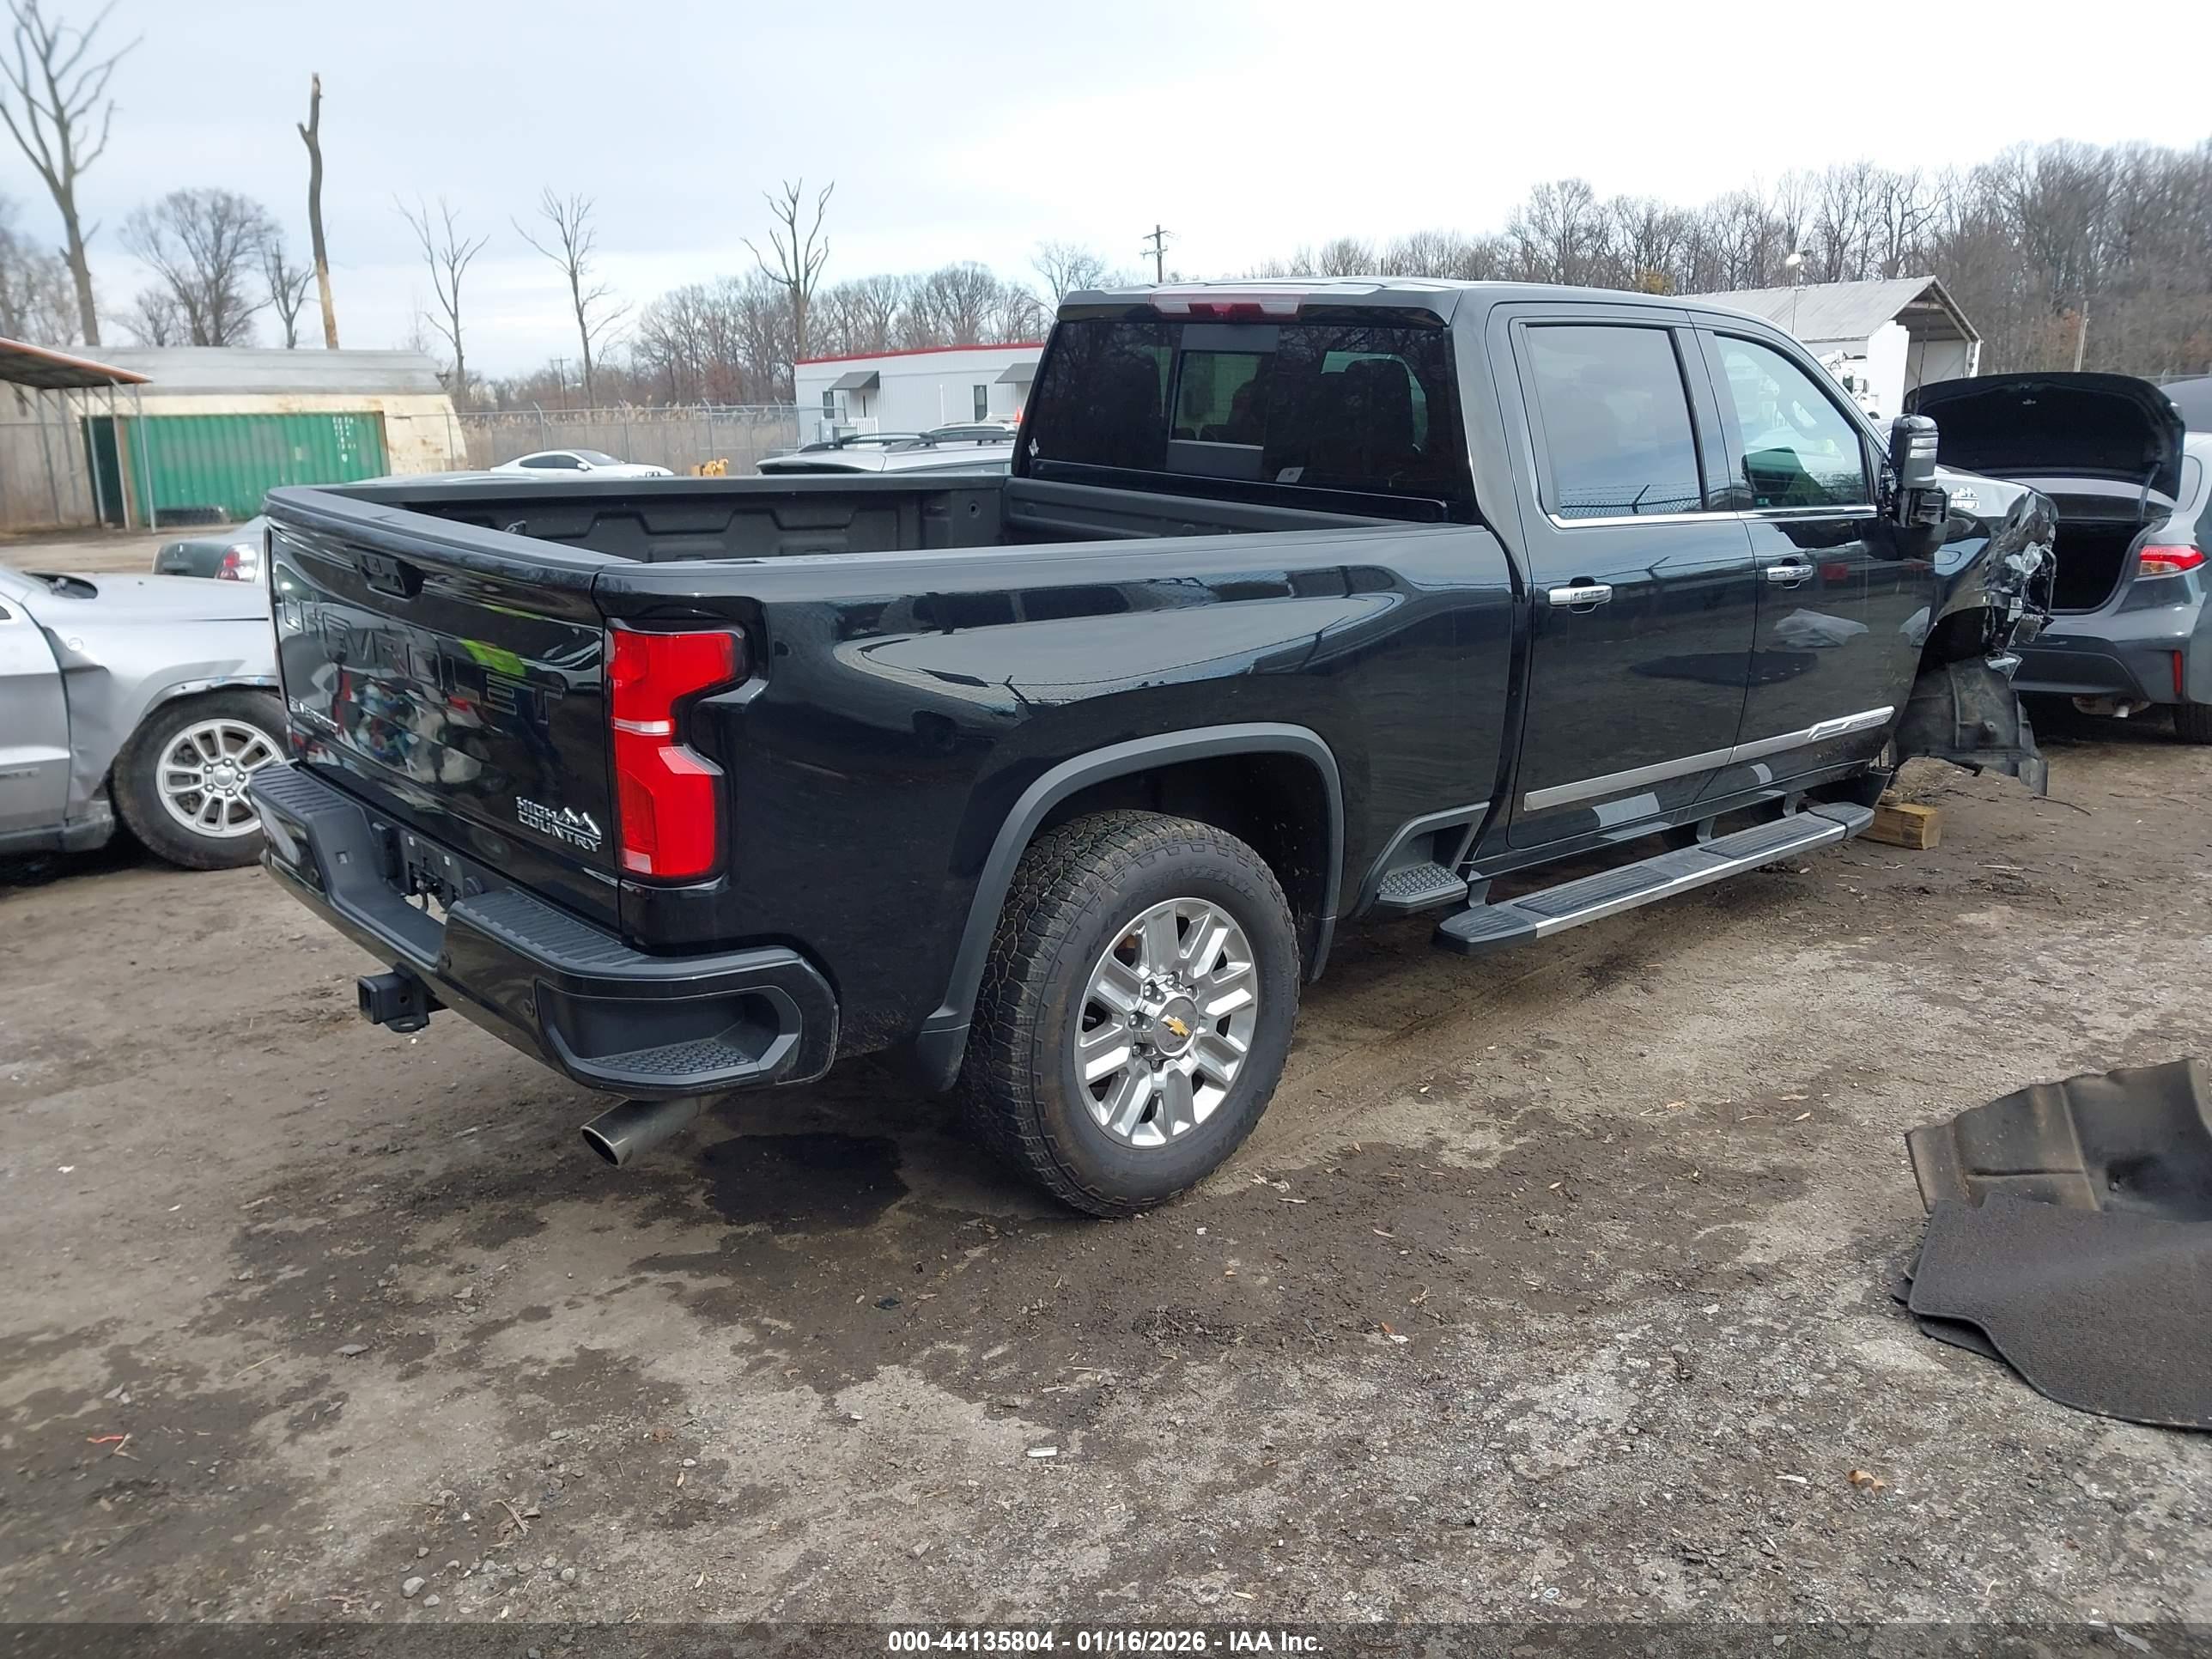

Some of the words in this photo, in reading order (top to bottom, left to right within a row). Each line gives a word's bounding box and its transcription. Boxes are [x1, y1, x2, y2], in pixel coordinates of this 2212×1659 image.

[282, 591, 563, 726] CHEVROLET
[516, 797, 557, 823] HIGH
[518, 810, 601, 852] COUNTRY
